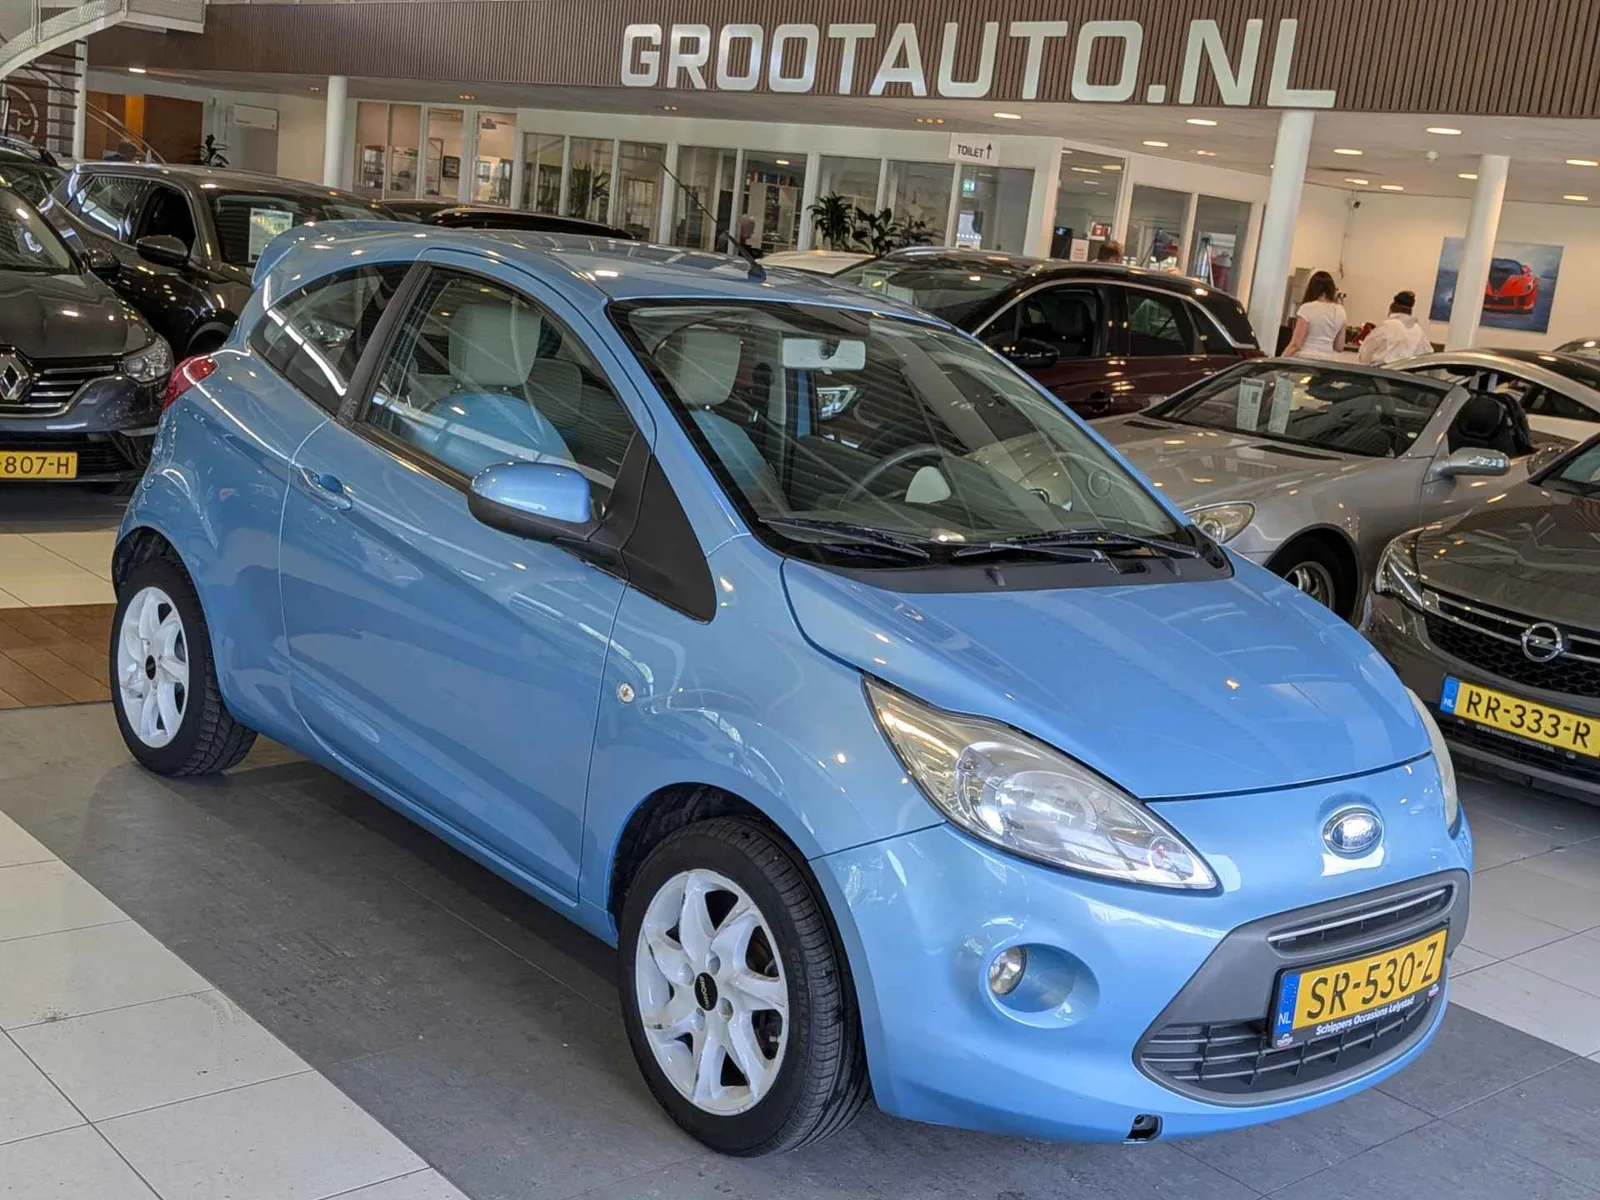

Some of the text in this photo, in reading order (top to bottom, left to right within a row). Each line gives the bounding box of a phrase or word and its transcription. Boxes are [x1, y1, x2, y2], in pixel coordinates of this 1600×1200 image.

[620, 18, 1337, 108] GROOTAUTO.NL
[957, 144, 984, 158] TOILET
[1466, 690, 1591, 749] RR-333-R
[1307, 941, 1438, 1019] SR-530-Z
[1277, 1012, 1291, 1026] NL
[1316, 1018, 1353, 1036] Schippers
[1353, 1007, 1388, 1025] Occasions
